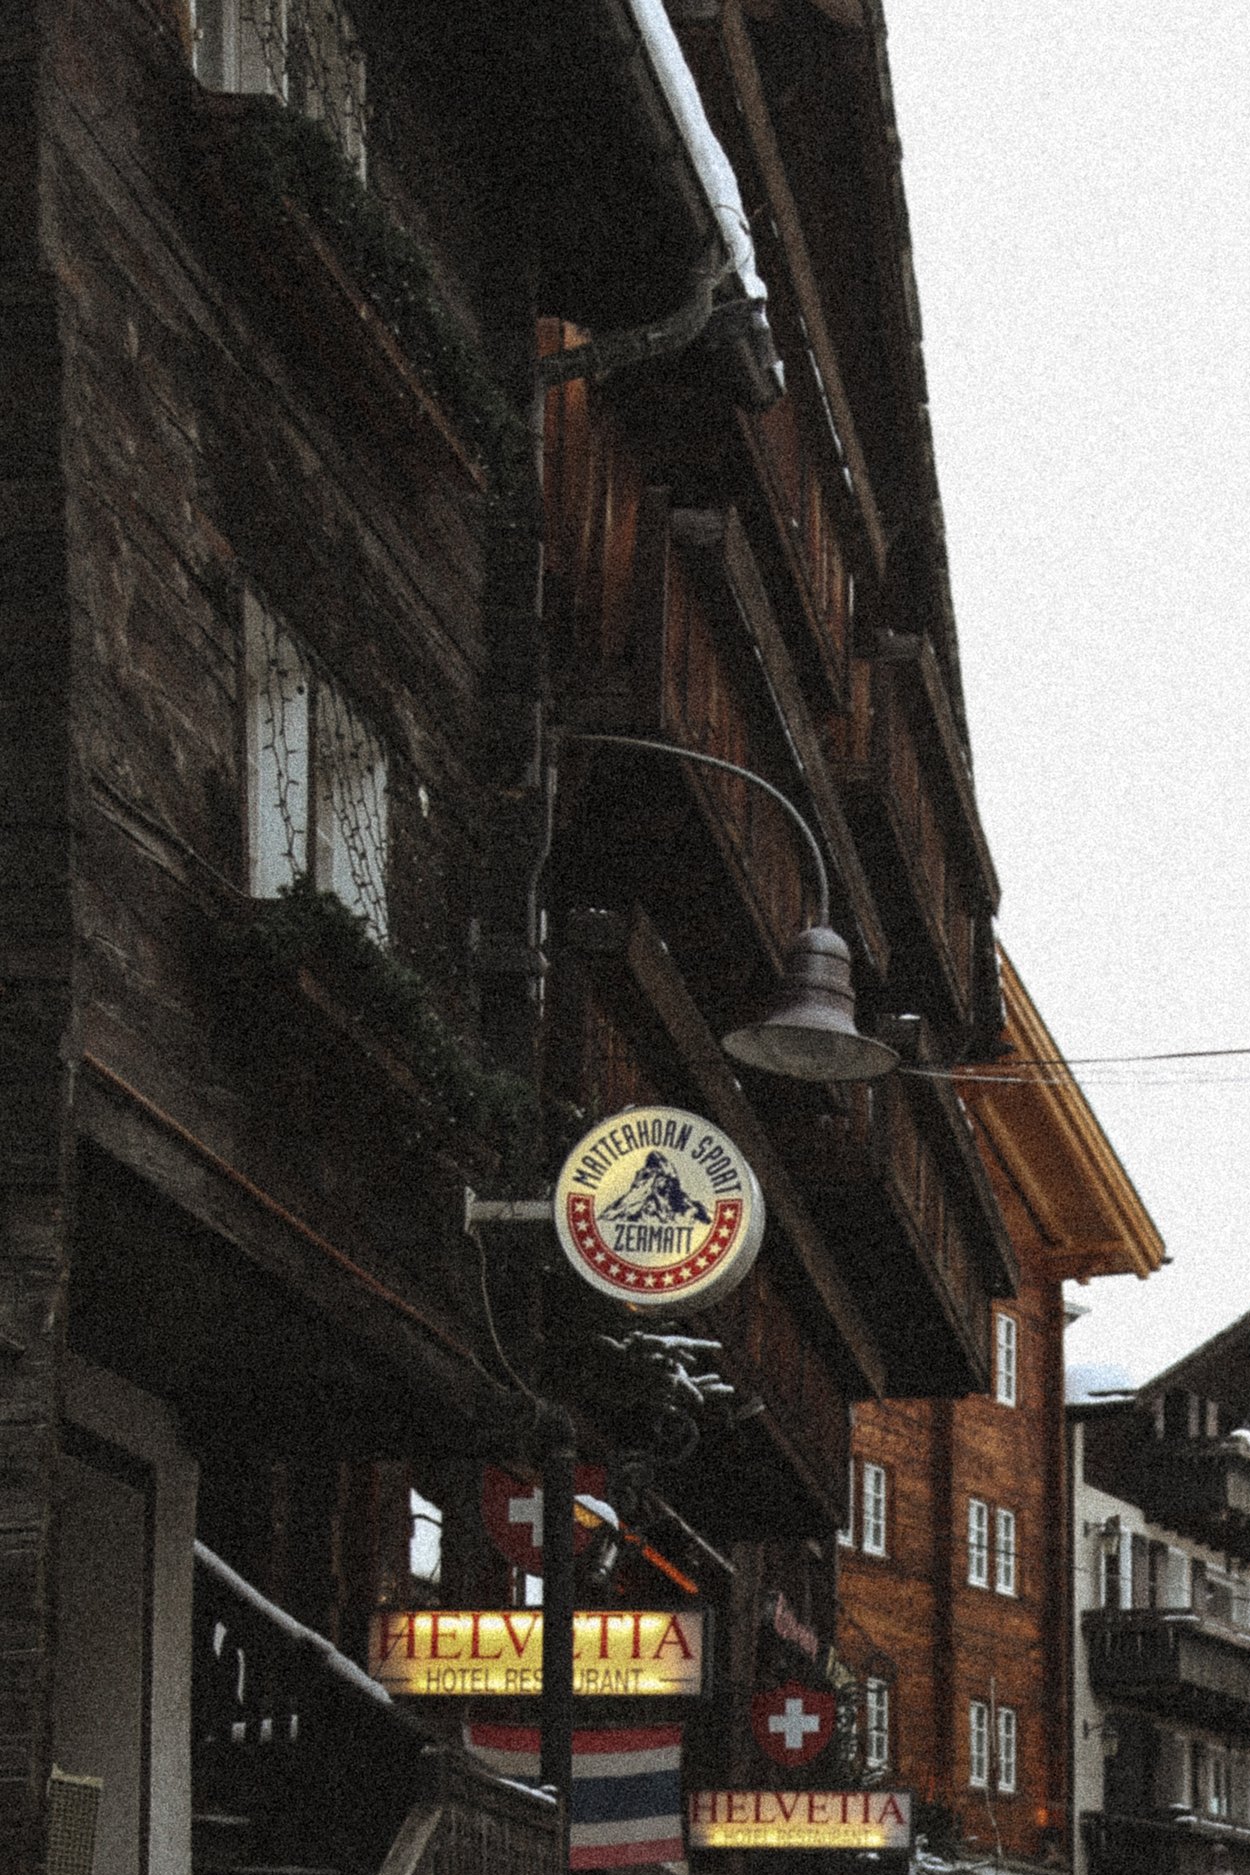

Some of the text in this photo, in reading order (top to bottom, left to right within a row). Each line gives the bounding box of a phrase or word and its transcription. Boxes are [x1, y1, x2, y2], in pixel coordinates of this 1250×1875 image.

[573, 1119, 742, 1194] MATTERHORN SPORT
[614, 1224, 694, 1254] ZERMATT
[375, 1612, 695, 1659] HELVTIA
[426, 1667, 643, 1694] HOTEL RESURANT
[691, 1792, 907, 1824] HELVETIA
